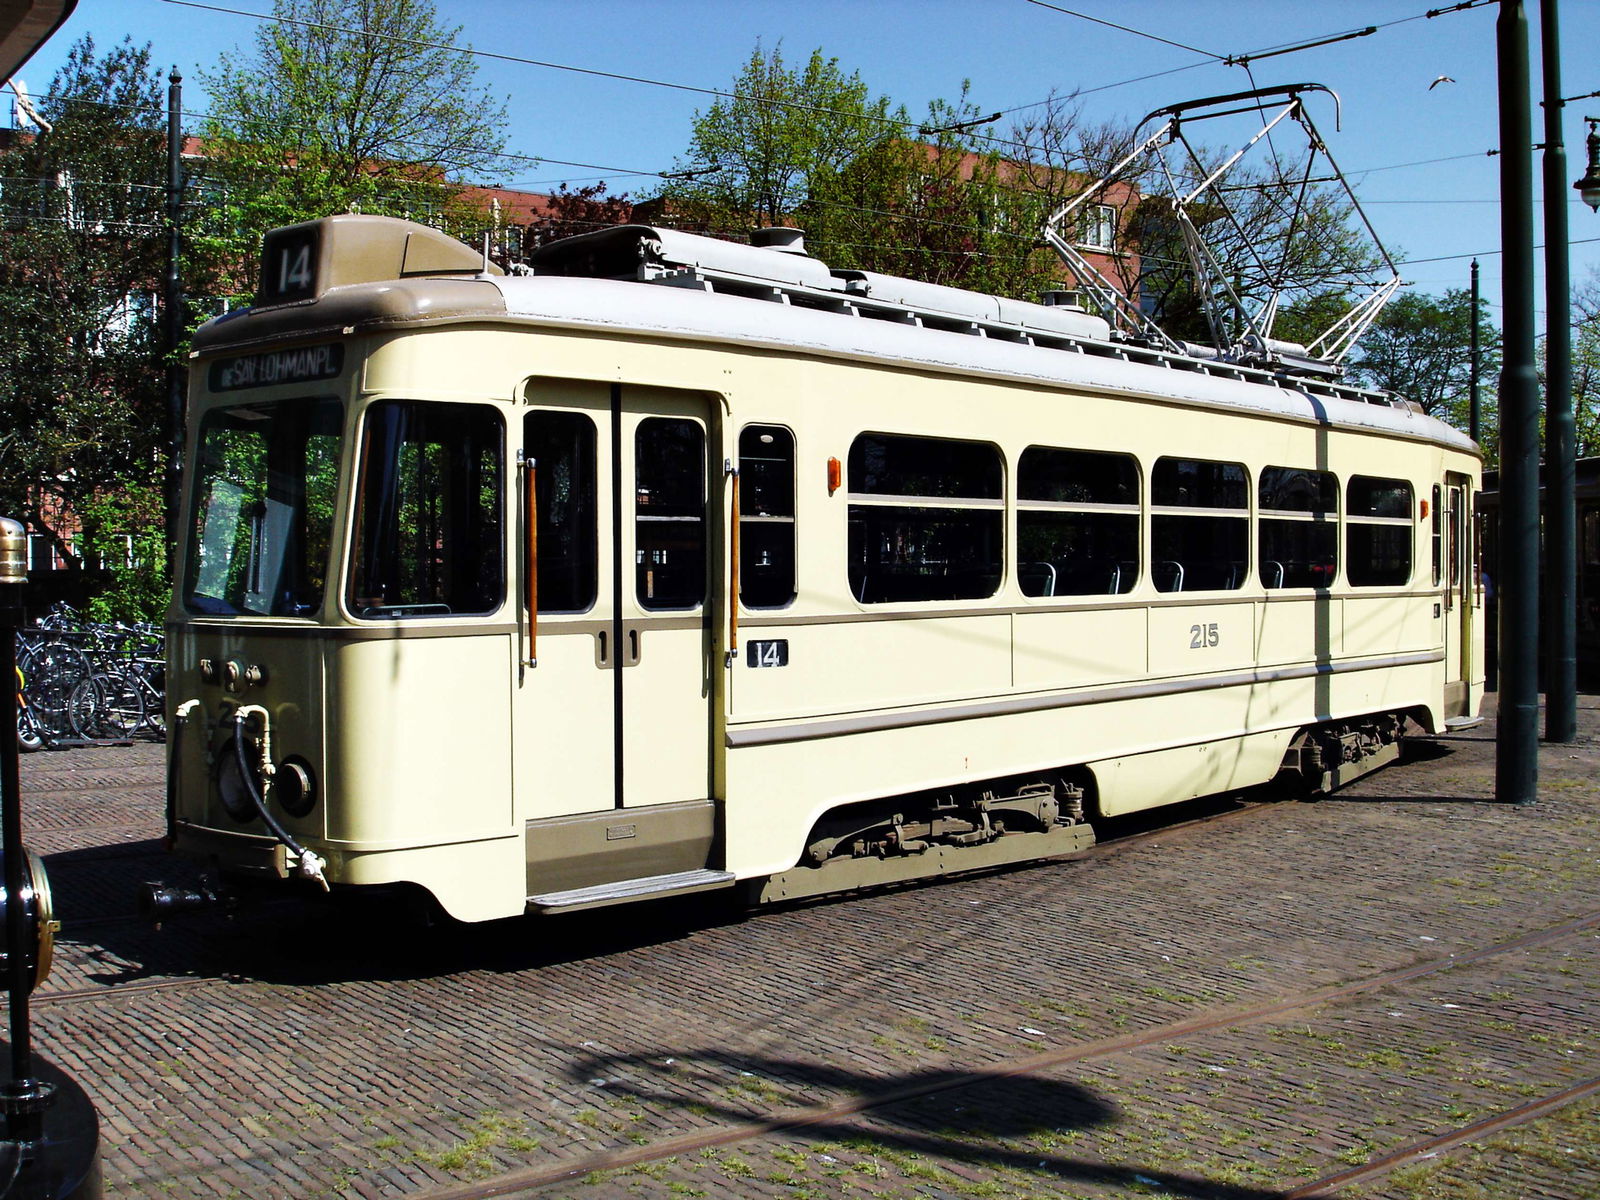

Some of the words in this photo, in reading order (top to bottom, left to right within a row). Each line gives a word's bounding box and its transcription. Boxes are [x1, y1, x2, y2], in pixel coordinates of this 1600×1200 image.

[279, 245, 312, 292] 14
[1190, 623, 1219, 649] 215
[756, 642, 780, 668] 14
